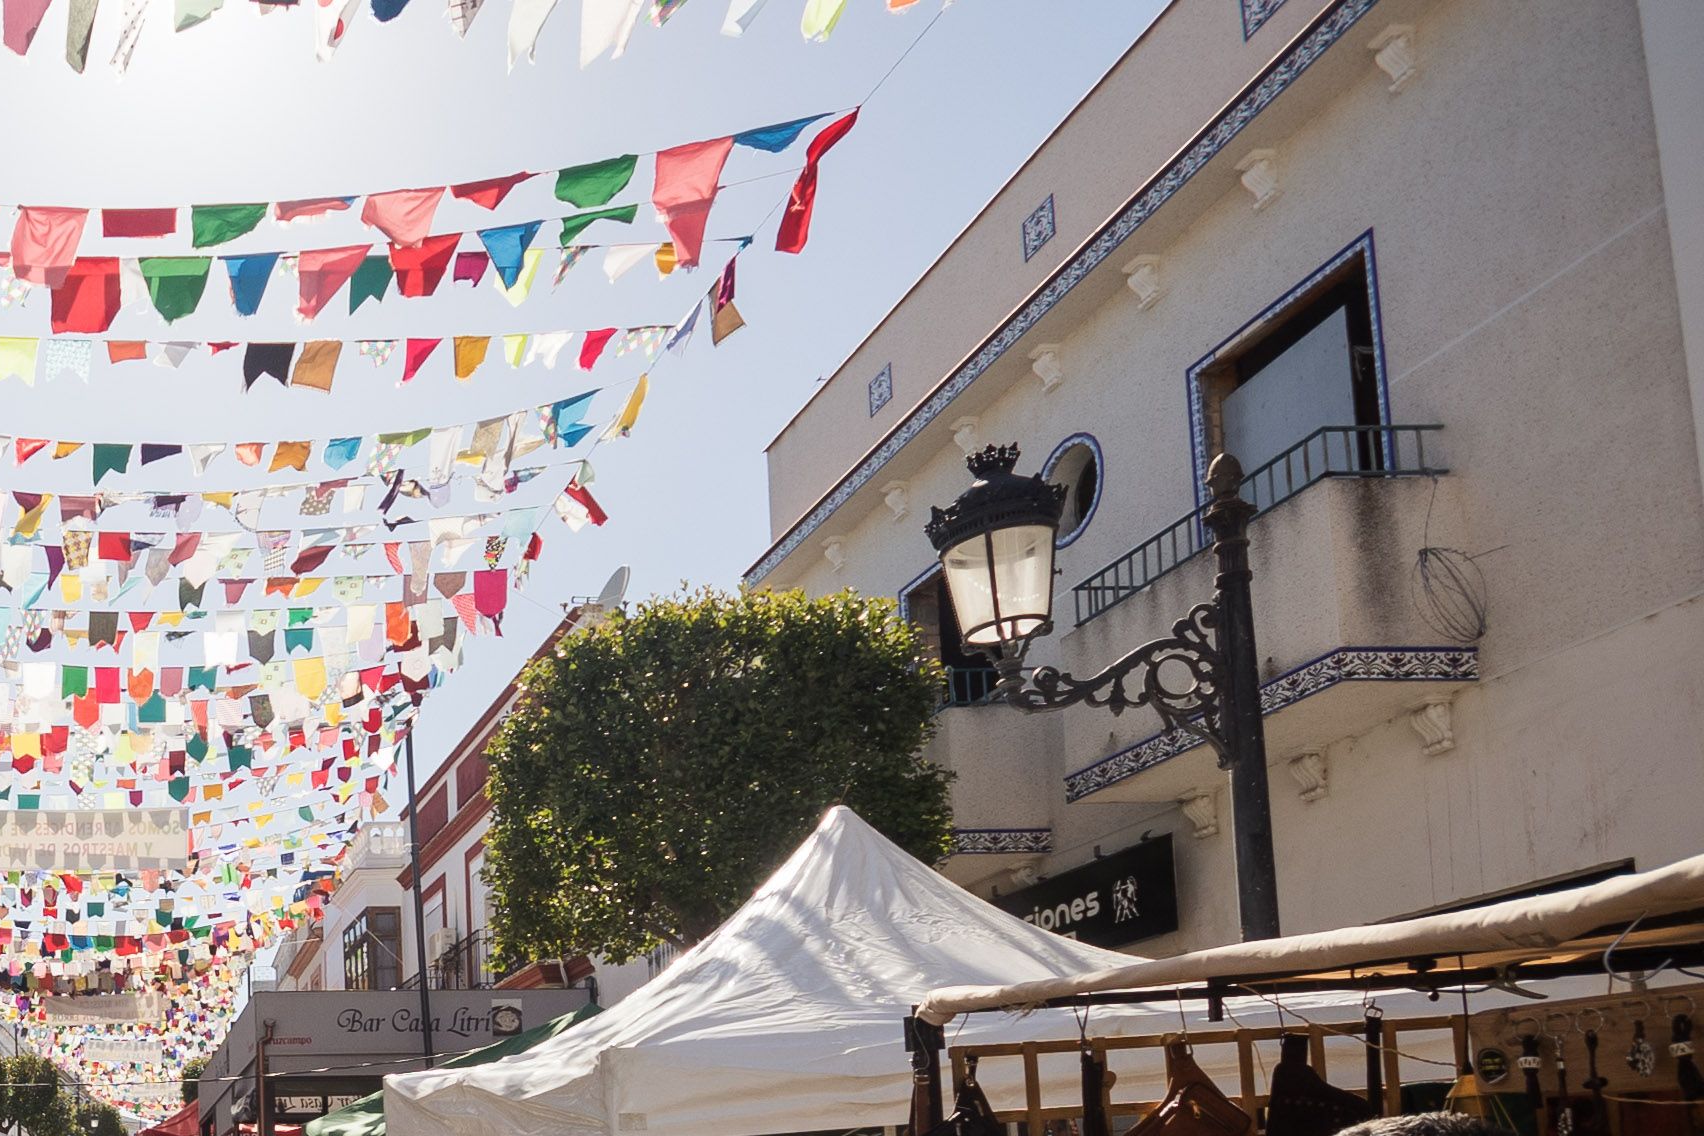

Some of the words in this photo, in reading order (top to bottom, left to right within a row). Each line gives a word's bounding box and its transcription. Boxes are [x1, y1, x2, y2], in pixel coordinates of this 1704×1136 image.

[1024, 891, 1100, 932] iones
[337, 1009, 385, 1033] Bar
[447, 1007, 493, 1037] Litri
[263, 1037, 312, 1046] ruzcampo
